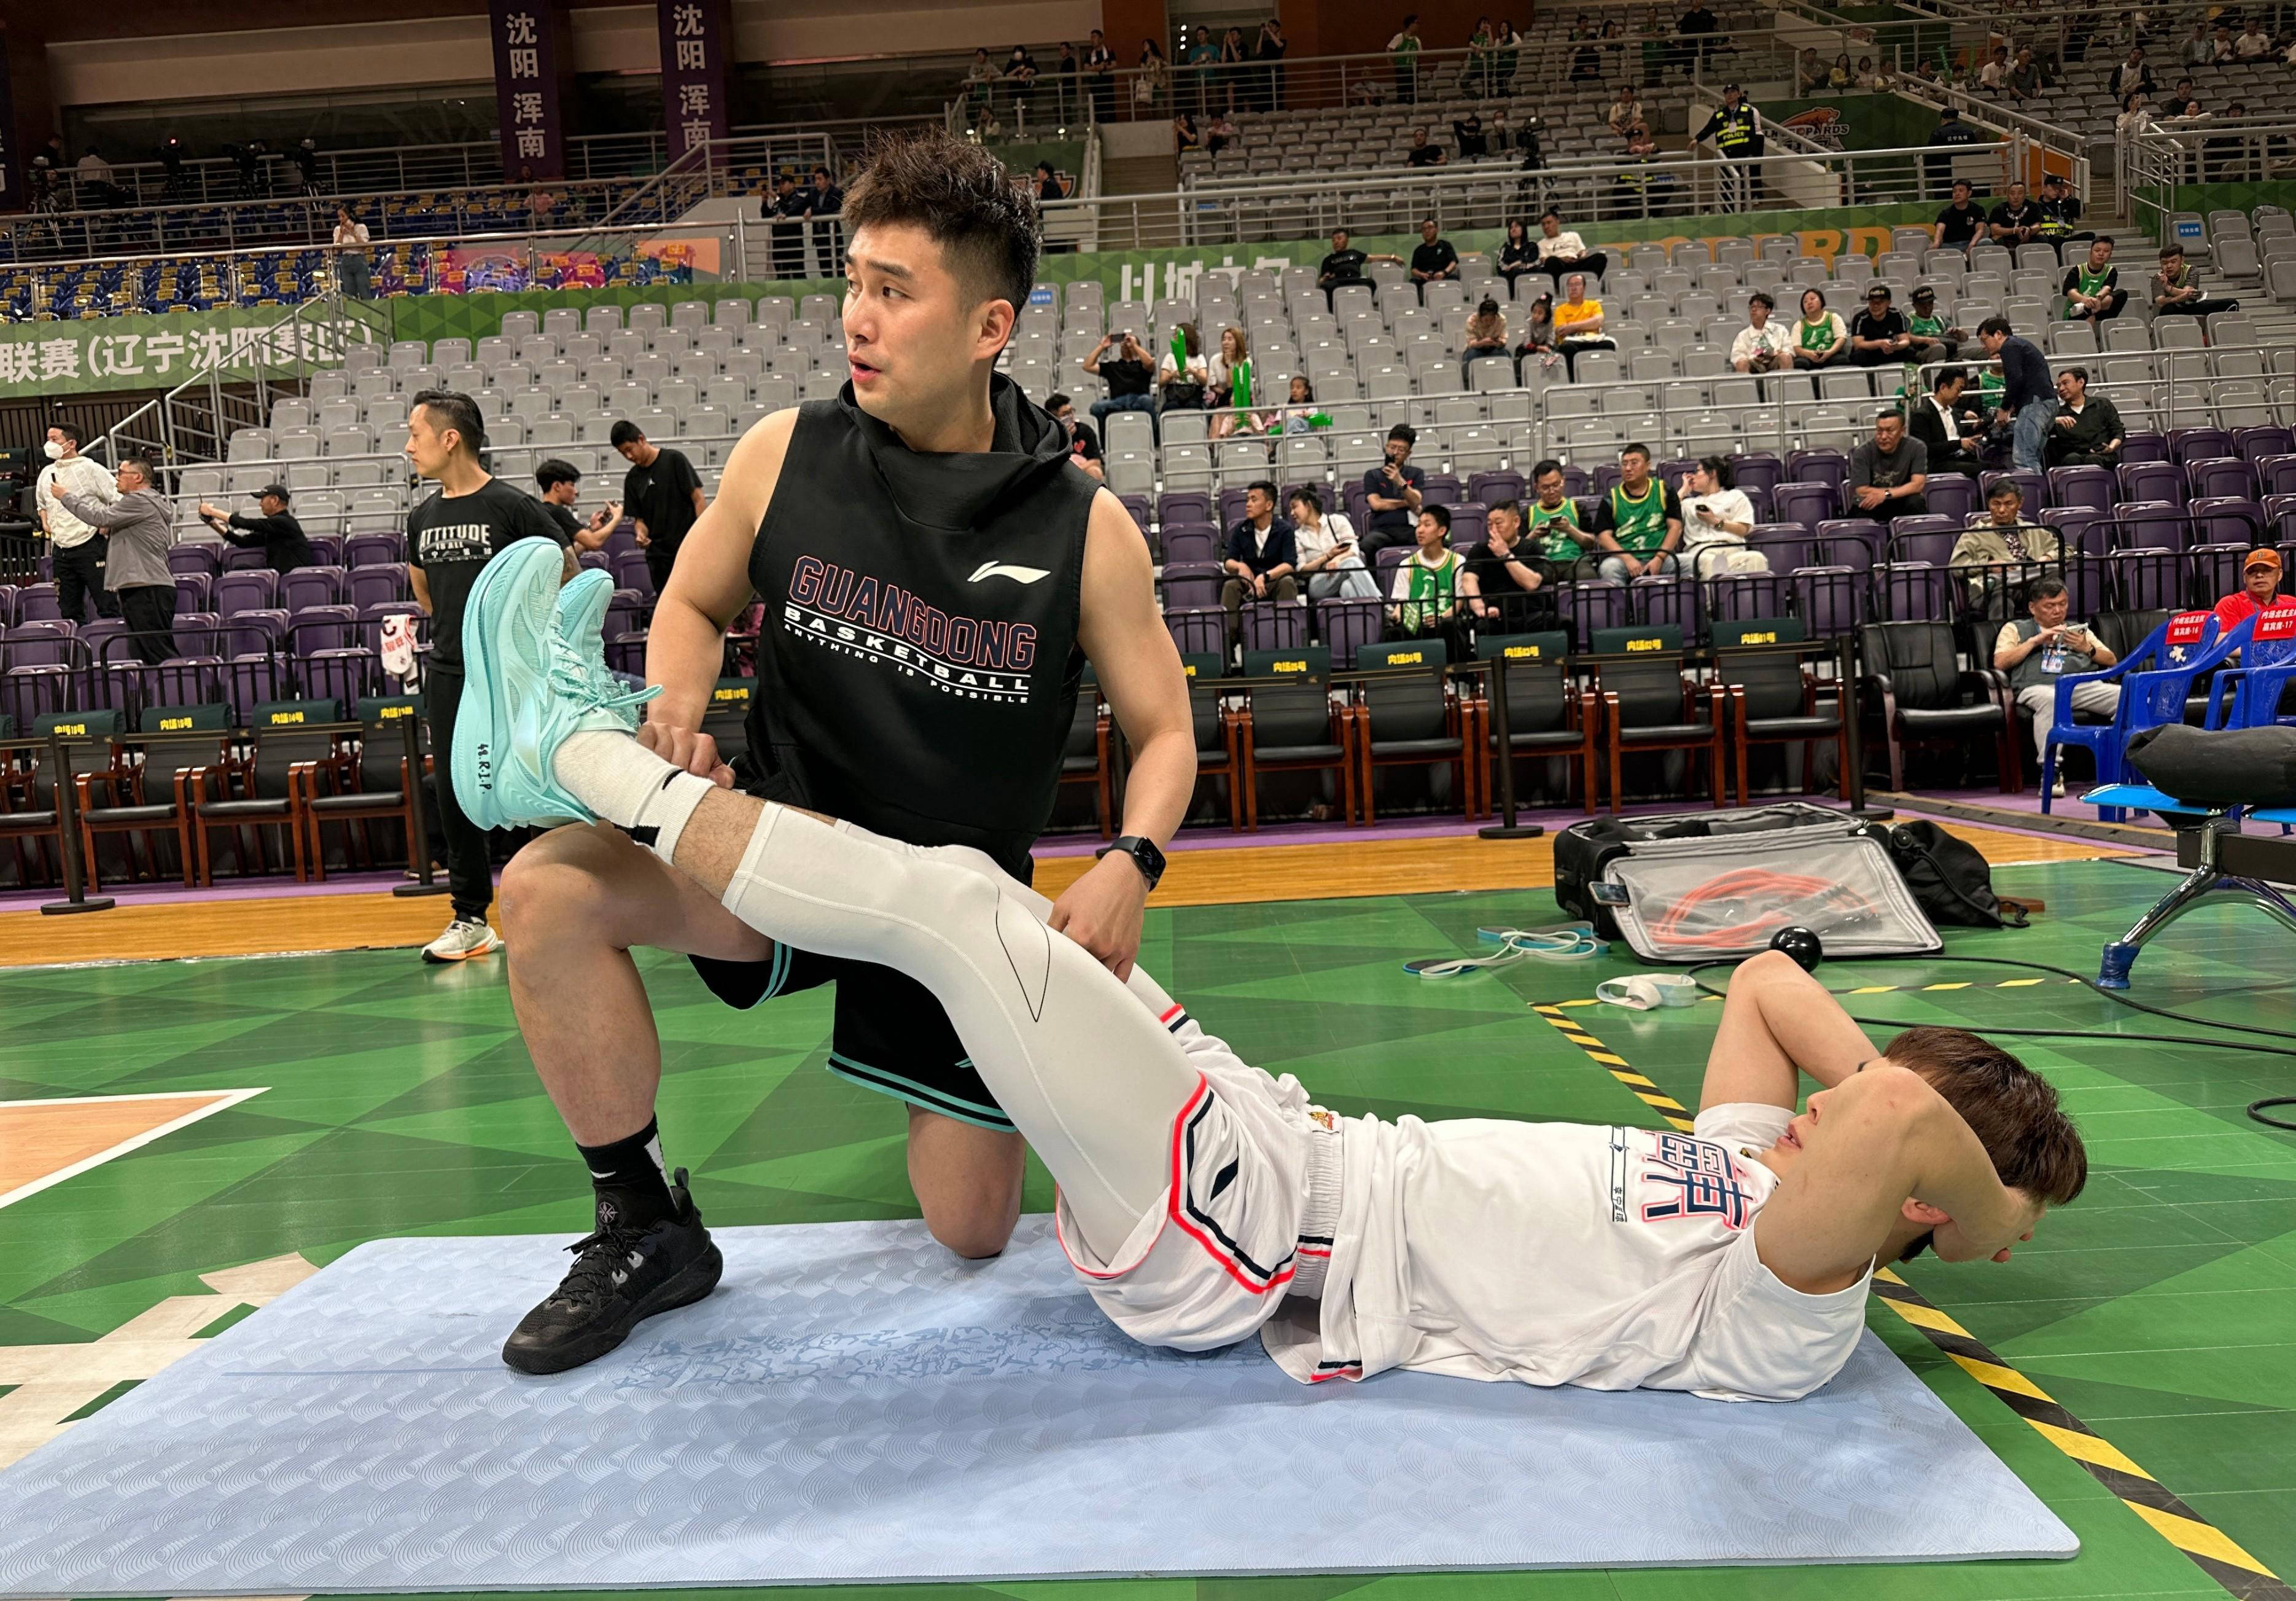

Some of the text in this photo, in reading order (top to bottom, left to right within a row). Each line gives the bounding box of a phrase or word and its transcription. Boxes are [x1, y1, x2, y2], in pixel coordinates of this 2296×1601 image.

[506, 12, 545, 158] 沈阳 浑南
[673, 4, 712, 151] 沈阳 浑南
[419, 524, 492, 553] ATTITUDE
[784, 606, 1030, 691] BASKETBALL
[788, 554, 1038, 670] GUANGDONG
[784, 624, 1030, 705] ANYTHING IS POSSIBLE
